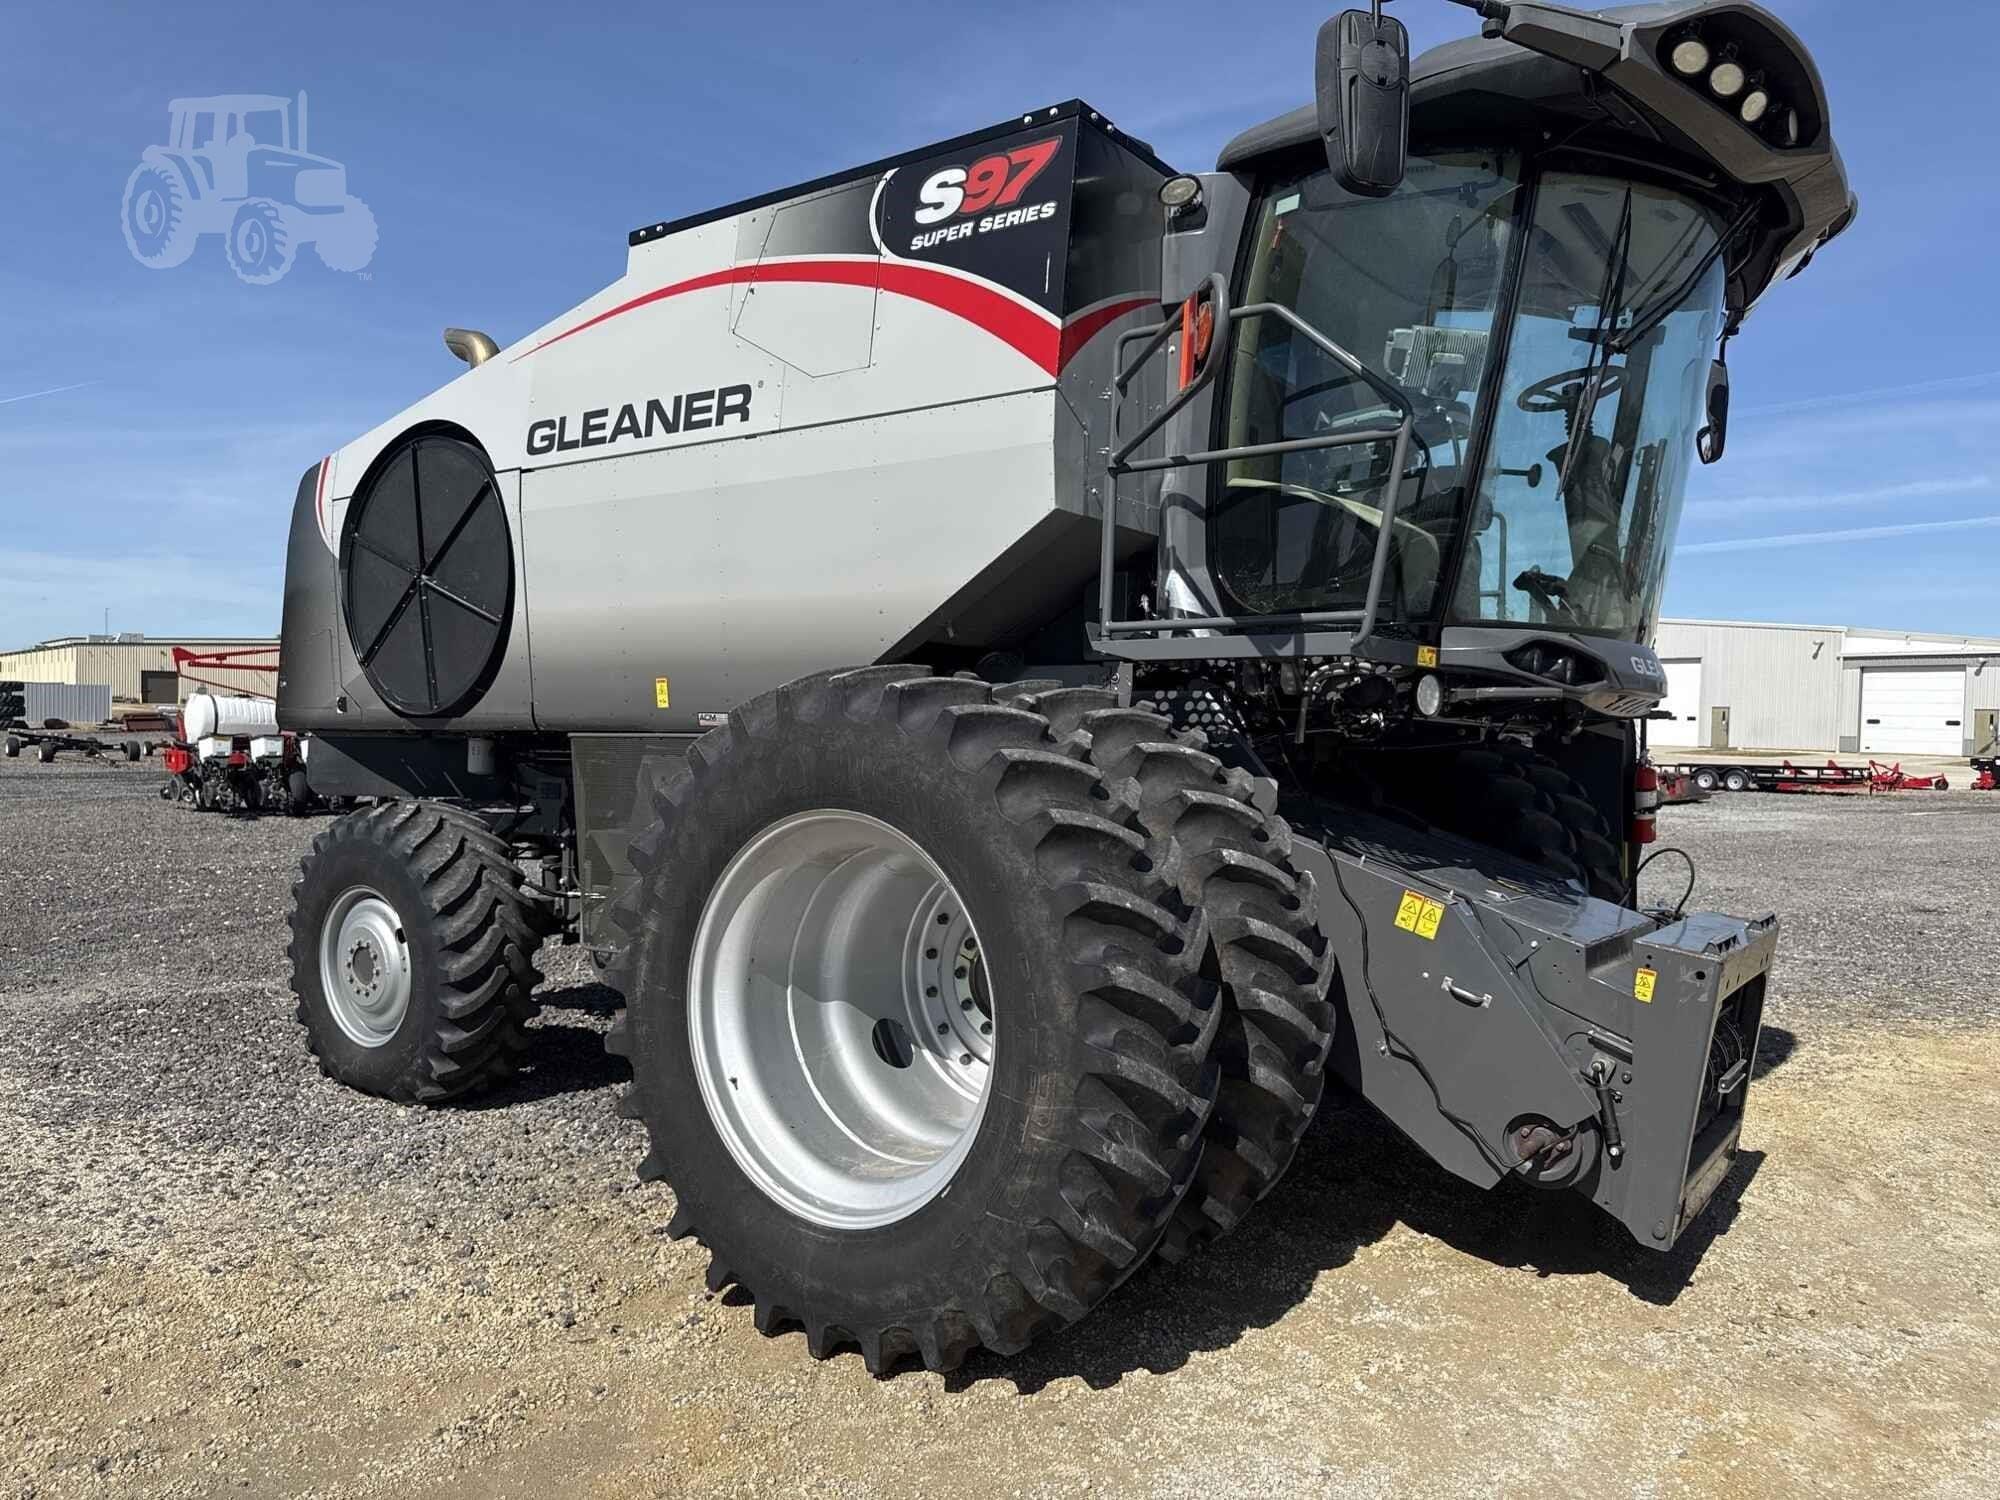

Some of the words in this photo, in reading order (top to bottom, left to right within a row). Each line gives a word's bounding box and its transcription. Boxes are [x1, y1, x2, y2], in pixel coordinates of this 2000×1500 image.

[914, 135, 1063, 225] S97
[910, 220, 974, 250] SUPER
[978, 201, 1058, 233] SERIES
[526, 383, 752, 456] GLEANER
